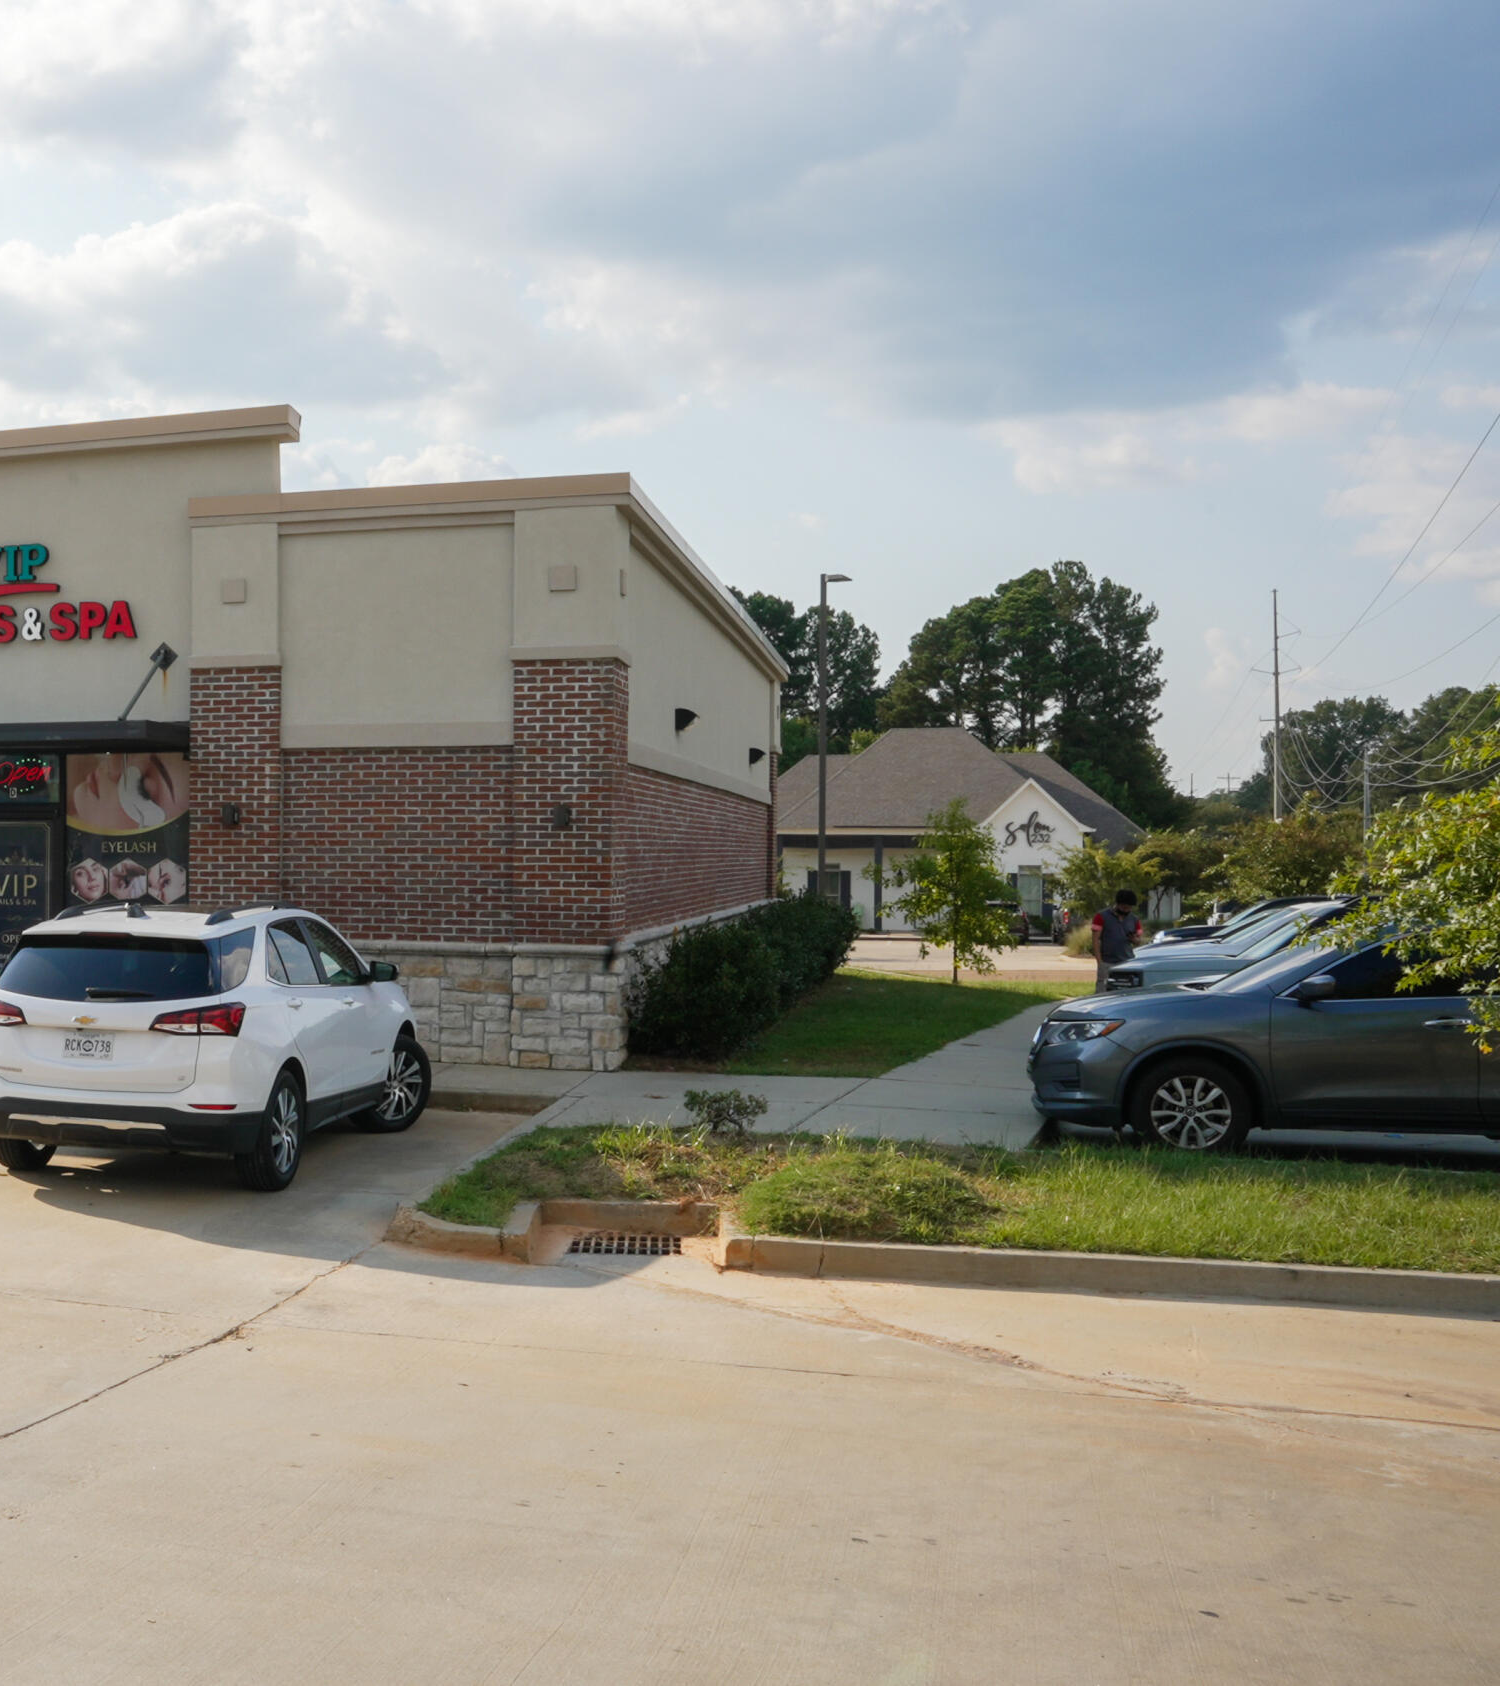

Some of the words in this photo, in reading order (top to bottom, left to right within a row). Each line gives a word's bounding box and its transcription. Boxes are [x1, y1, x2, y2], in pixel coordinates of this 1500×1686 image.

[21, 607, 44, 641] &
[49, 600, 137, 641] SPA
[1030, 833, 1051, 844] 232
[101, 841, 157, 853] EYELASH
